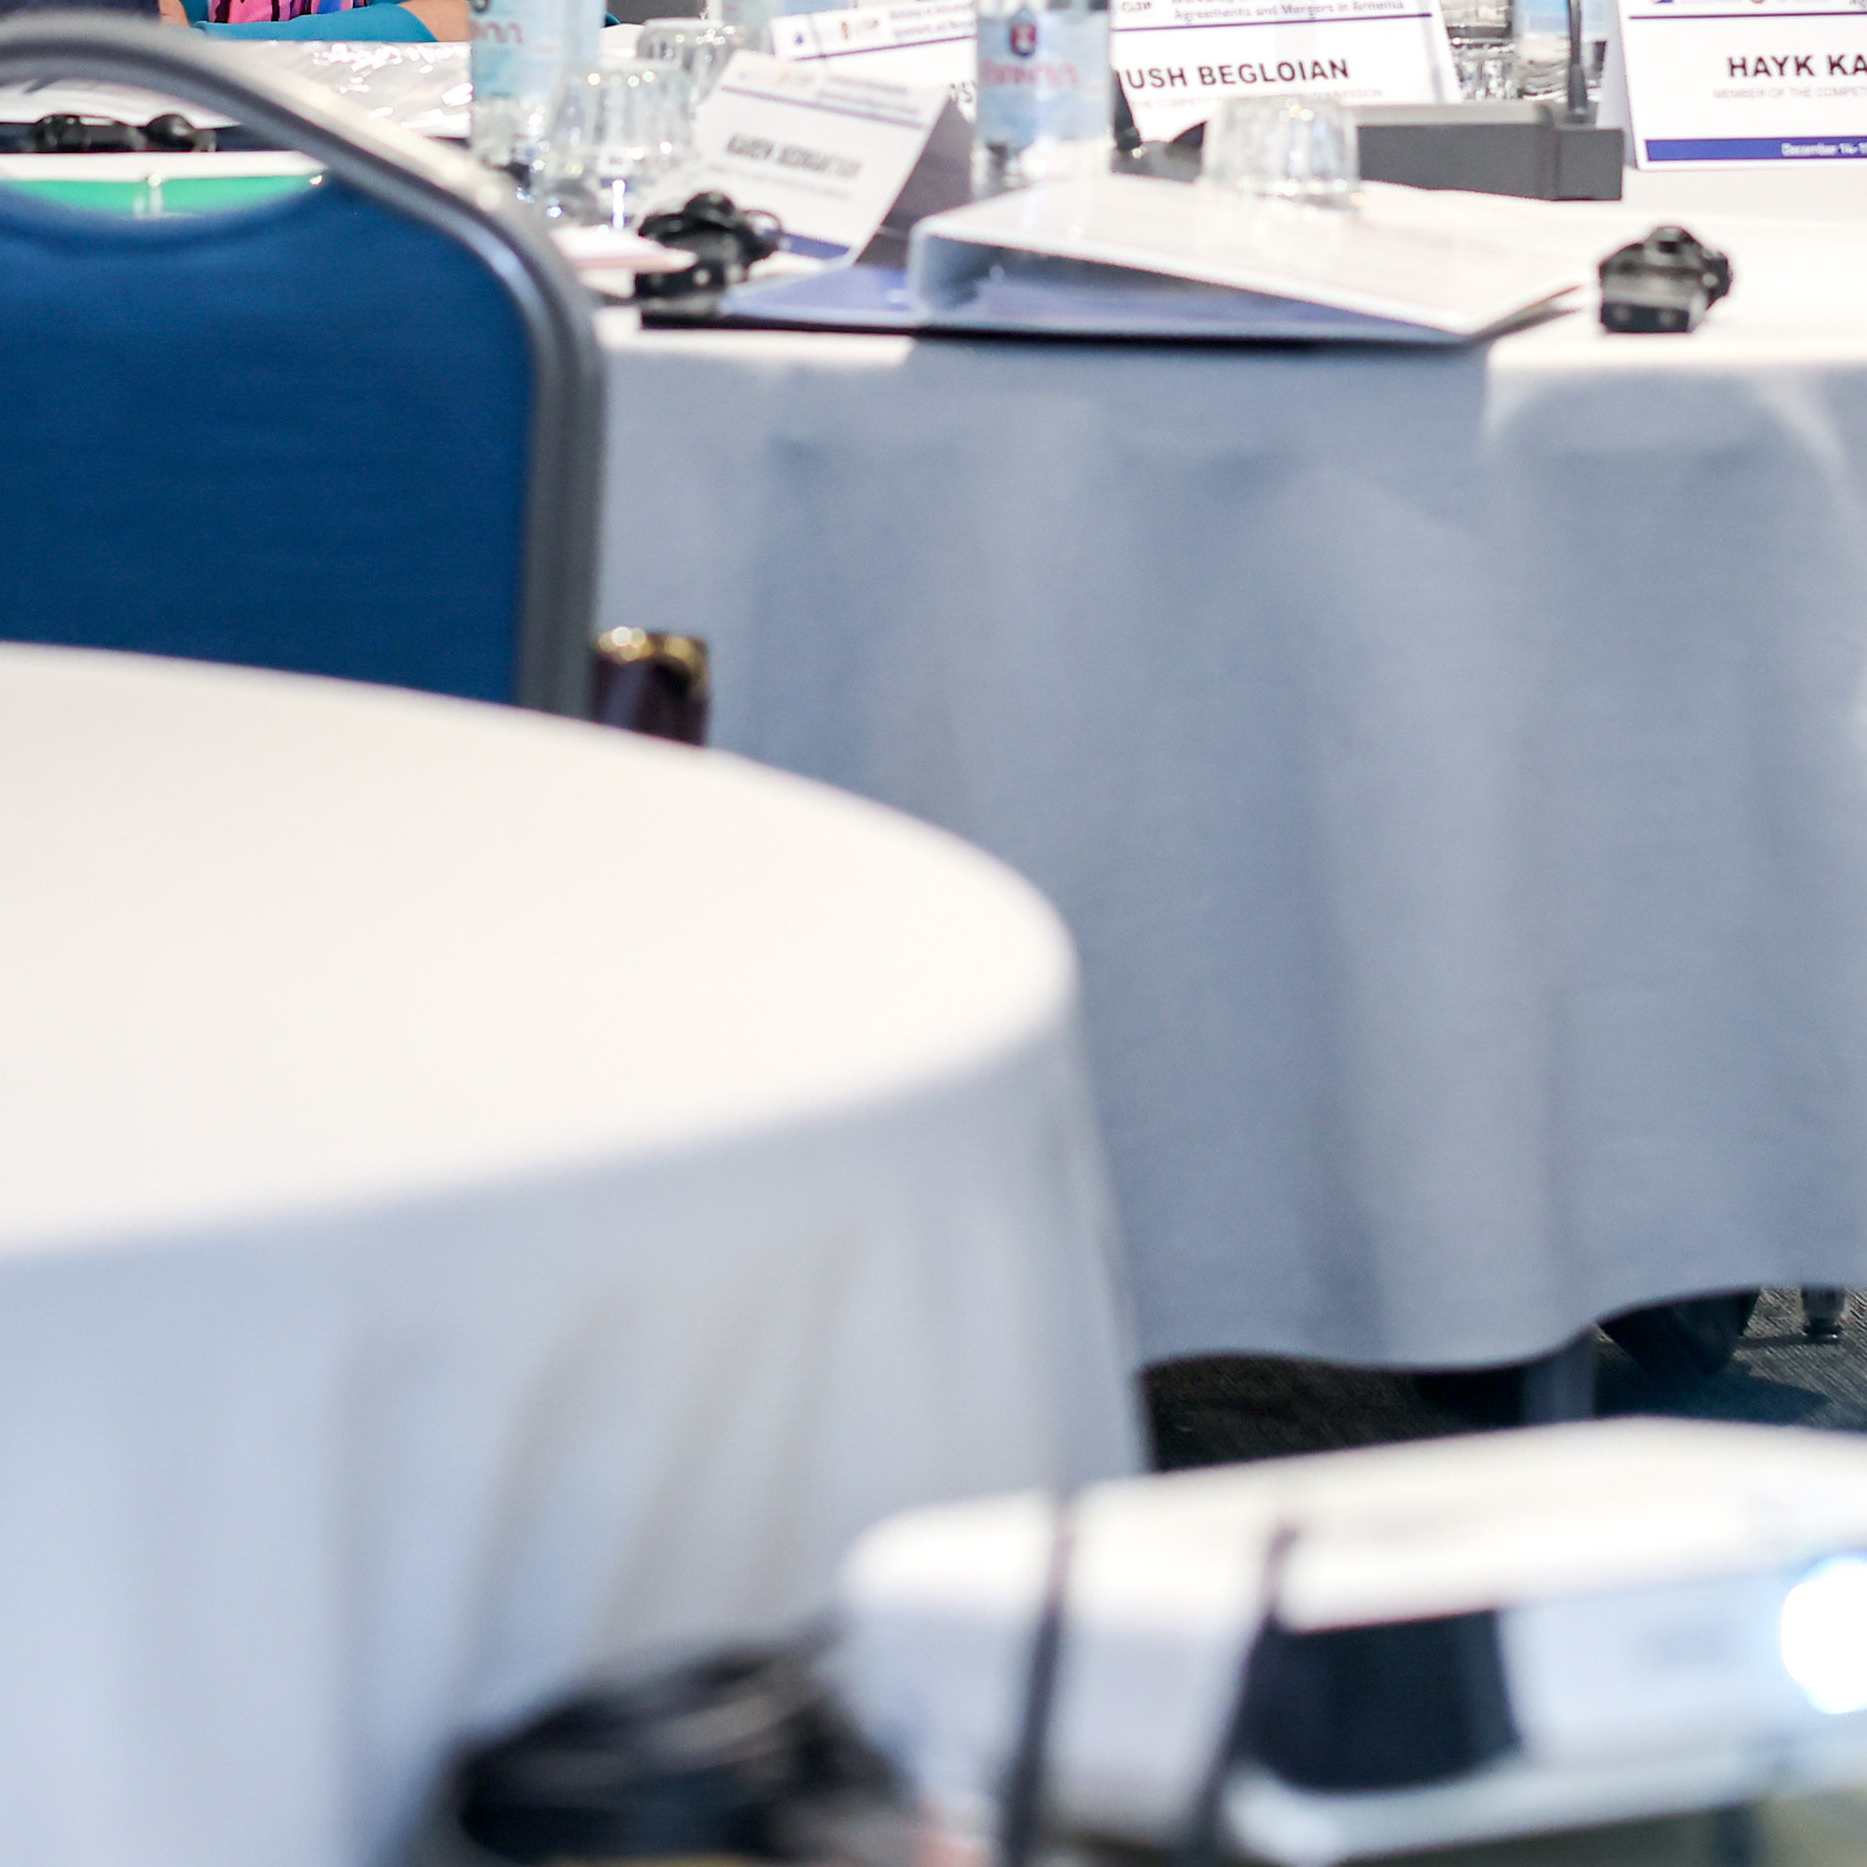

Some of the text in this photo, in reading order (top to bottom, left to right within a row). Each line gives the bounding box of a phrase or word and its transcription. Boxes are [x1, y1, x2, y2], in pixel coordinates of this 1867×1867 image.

[1126, 57, 1350, 89] USH BEGLOIAN
[1726, 55, 1815, 77] HAYK
